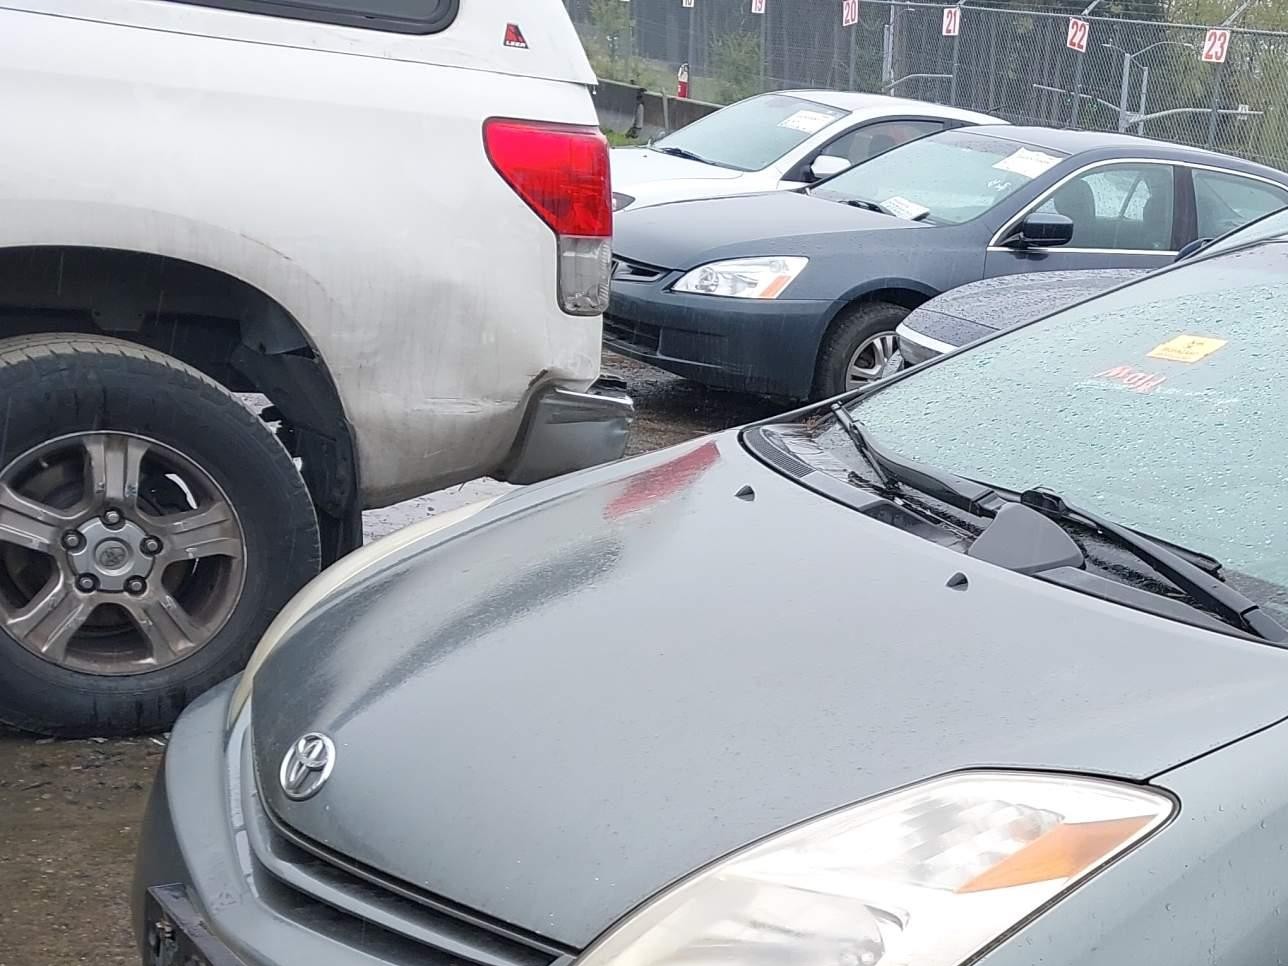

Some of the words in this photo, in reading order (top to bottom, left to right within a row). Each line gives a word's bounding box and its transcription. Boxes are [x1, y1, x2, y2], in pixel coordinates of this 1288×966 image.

[844, 0, 857, 24] 20
[945, 9, 957, 34] 21
[1069, 20, 1087, 50] 22
[1204, 31, 1227, 61] 23
